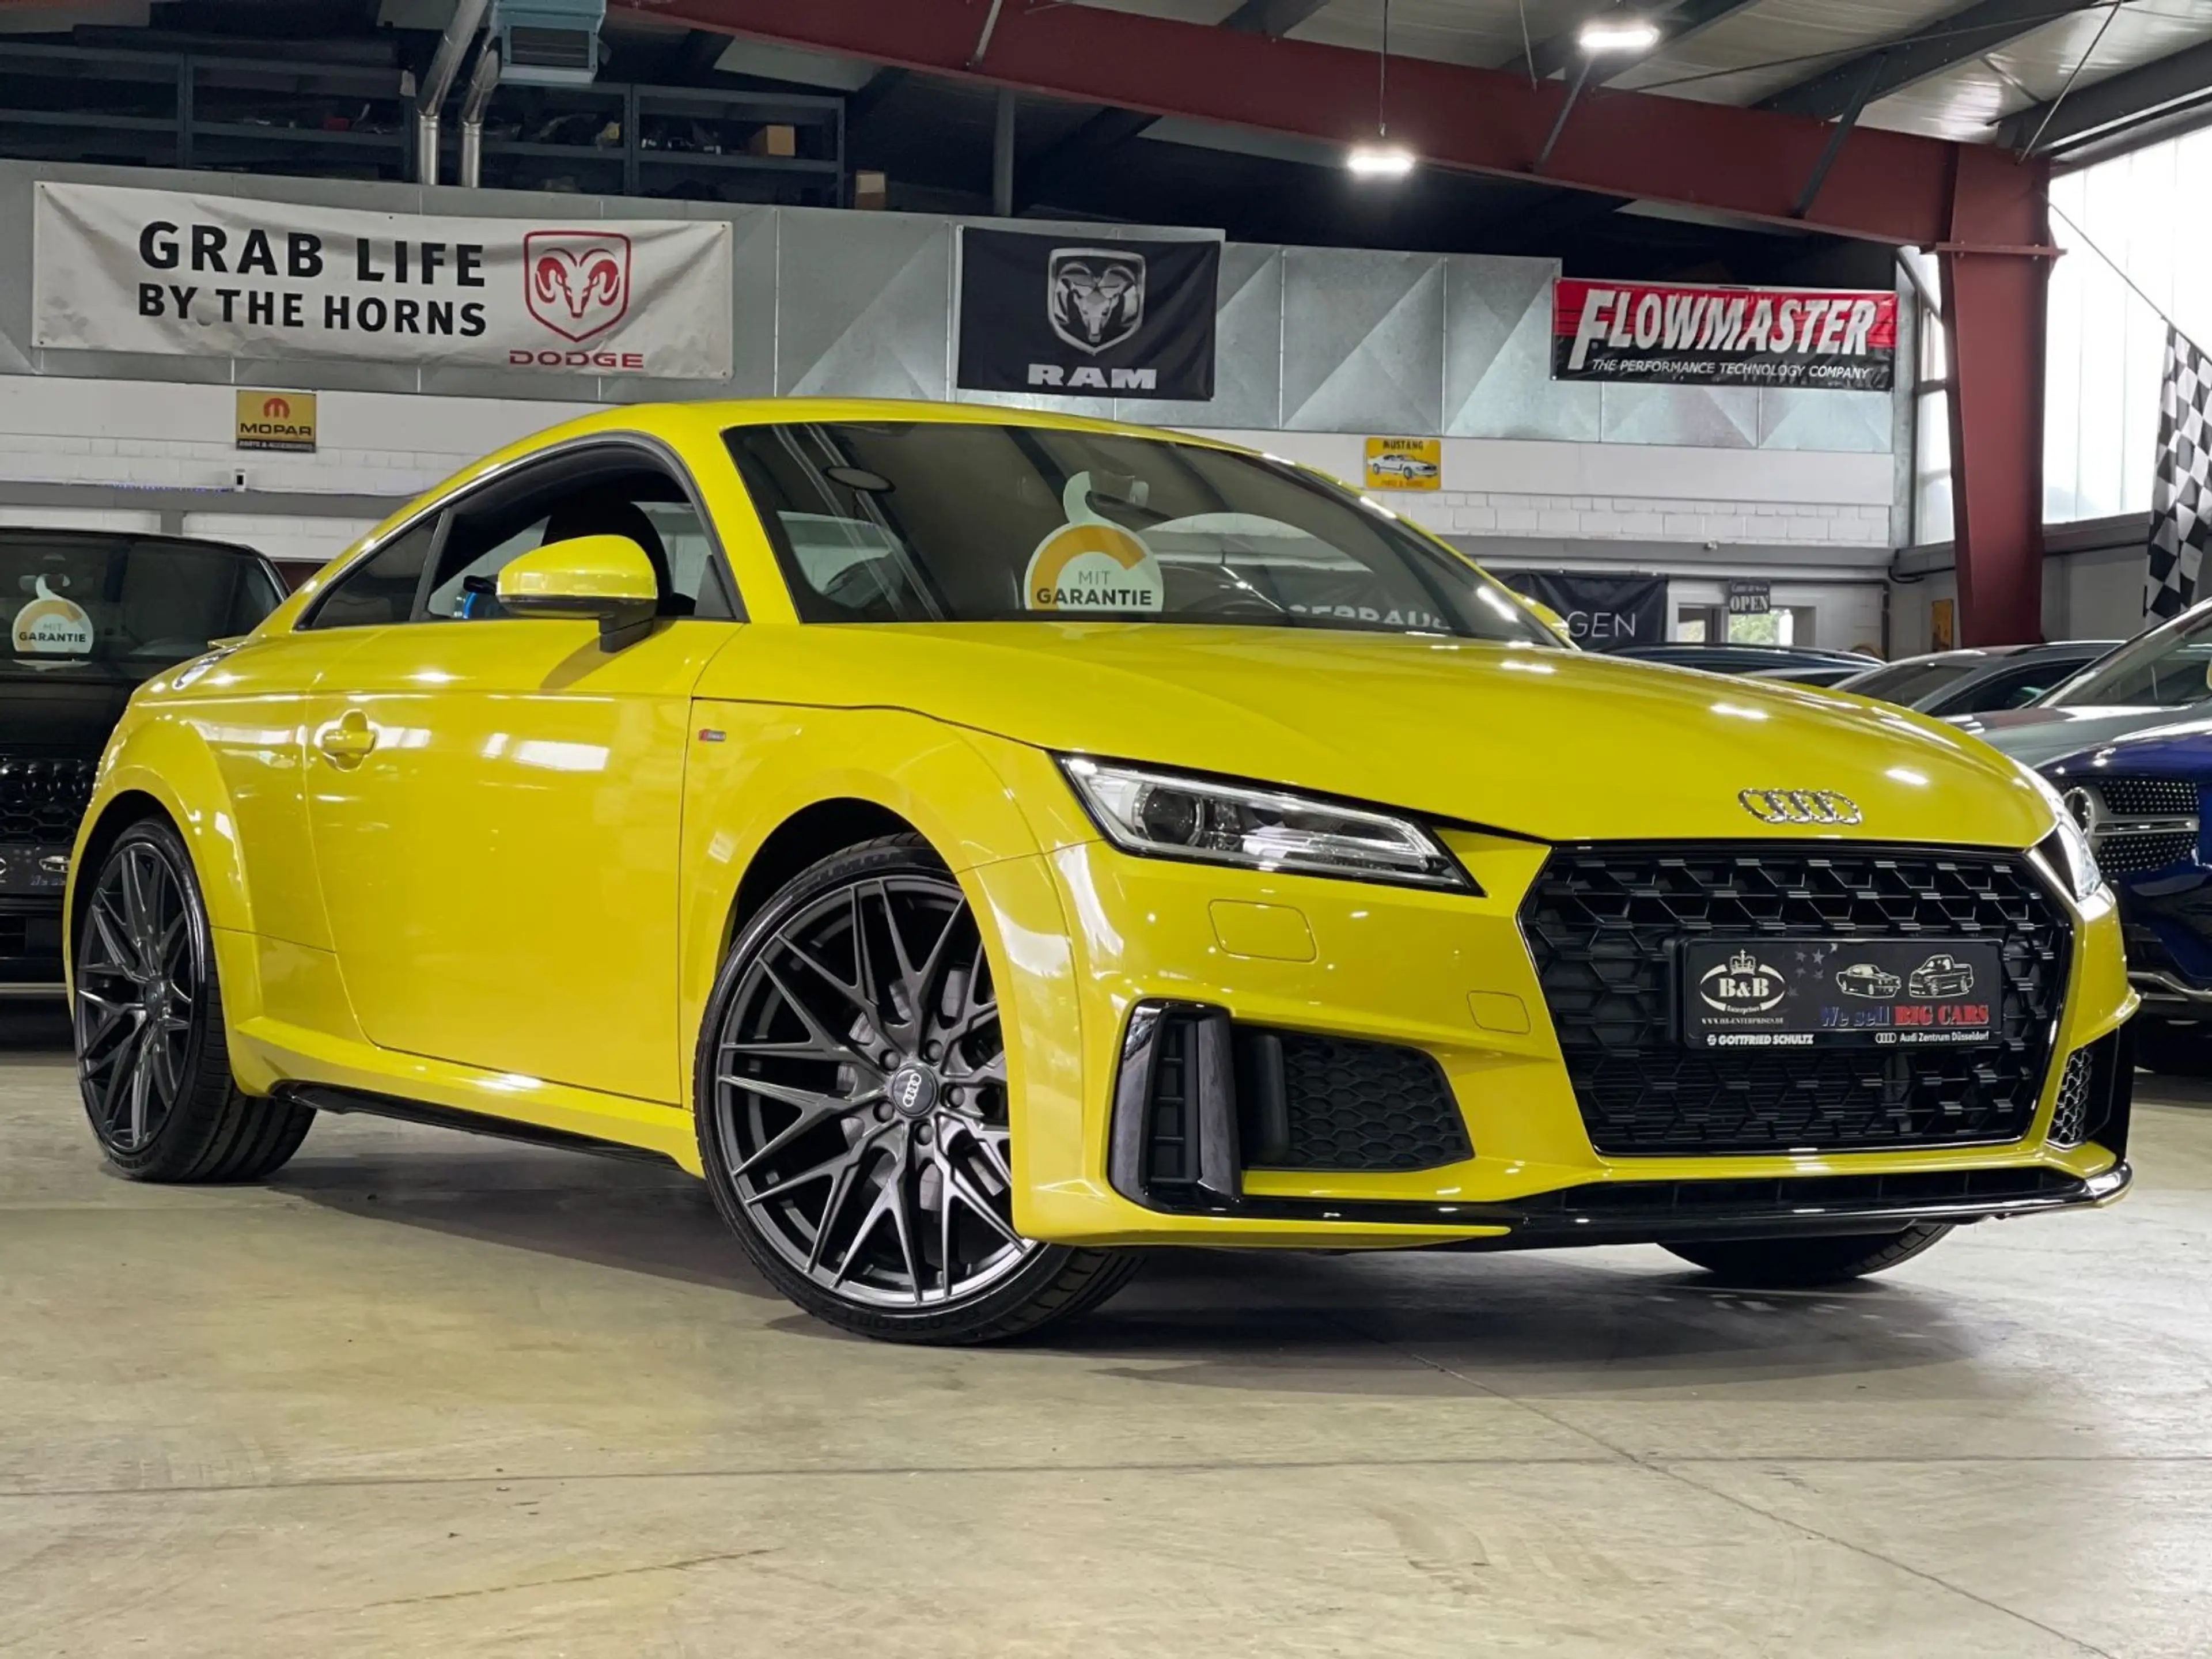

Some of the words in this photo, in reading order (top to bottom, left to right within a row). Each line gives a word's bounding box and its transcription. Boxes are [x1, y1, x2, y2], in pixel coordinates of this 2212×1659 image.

[139, 221, 323, 278] GRAB
[356, 237, 486, 287] LIFE
[138, 282, 198, 319] BY
[215, 289, 304, 327] THE
[324, 294, 487, 337] HORNS
[1567, 288, 1877, 370] FLOWMASTER
[509, 350, 644, 368] DODGE
[1027, 363, 1157, 389] RAM
[1593, 359, 1618, 371] THE
[1620, 359, 1715, 374] PERFORMANCE
[1719, 362, 1805, 376] TECHNOLOGY
[1809, 365, 1870, 378] COMPANY
[240, 423, 312, 436] MOPAR
[1383, 440, 1424, 450] MUSTANG
[1078, 570, 1111, 585] MIT
[1037, 588, 1152, 605] GARANTIE
[1730, 595, 1769, 611] OPEN
[43, 623, 63, 631] MIT
[19, 632, 86, 642] GARANTIE
[1719, 977, 1770, 997] B&B
[1894, 1005, 1933, 1025] BIG
[1937, 1005, 1989, 1025] CARS
[1718, 1035, 1771, 1045] GOTTFRIED
[1772, 1034, 1814, 1044] SCHULTZ
[1900, 1033, 1917, 1041] Audi
[1918, 1032, 1950, 1041] Zentrum
[1951, 1031, 1989, 1041] Düsseldorf
